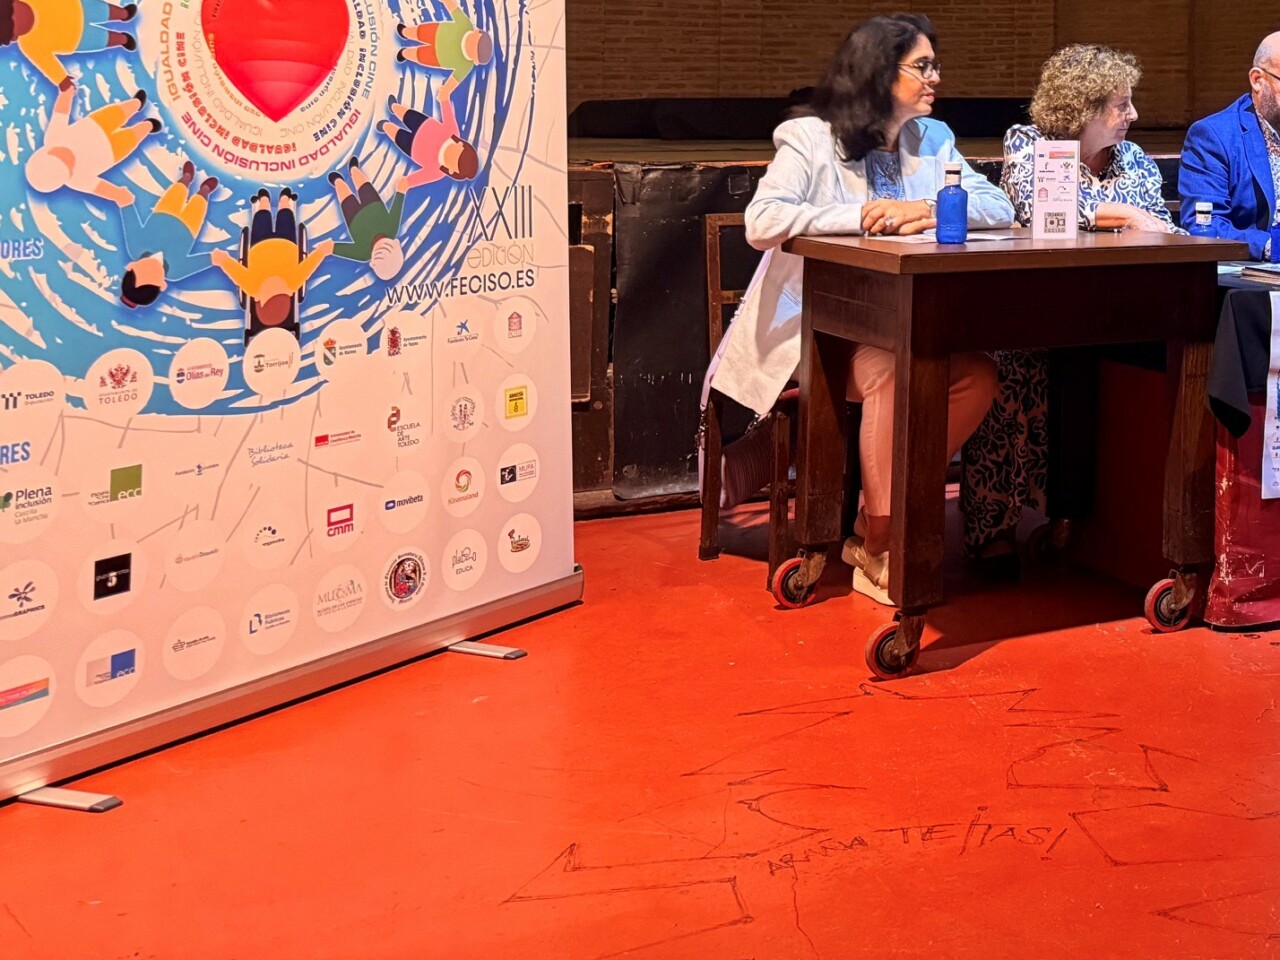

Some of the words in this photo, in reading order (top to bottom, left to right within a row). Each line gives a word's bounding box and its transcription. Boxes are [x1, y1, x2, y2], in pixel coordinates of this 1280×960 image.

[160, 1, 181, 102] IGUALDAD
[175, 31, 186, 68] CINE
[361, 60, 377, 100] CINE
[181, 112, 222, 156] CINE
[300, 108, 362, 166] IGUALDAD
[312, 119, 338, 142] CINE
[231, 136, 297, 155] IGUALDAD
[223, 147, 297, 172] INCLUSIÓN
[467, 184, 534, 243] XXIII
[386, 269, 535, 305] WWW.FECISO.ES
[210, 367, 224, 378] Rey
[25, 391, 55, 401] TOLEDO
[98, 393, 138, 405] TOLEDO
[397, 422, 421, 431] ESCUELA
[398, 439, 420, 448] TOLEDO
[519, 464, 535, 473] MUPA
[15, 486, 52, 502] Plena
[396, 494, 424, 508] movibeta
[15, 498, 52, 510] inclusión
[327, 522, 355, 538] cmm
[455, 565, 474, 576] EDUCA
